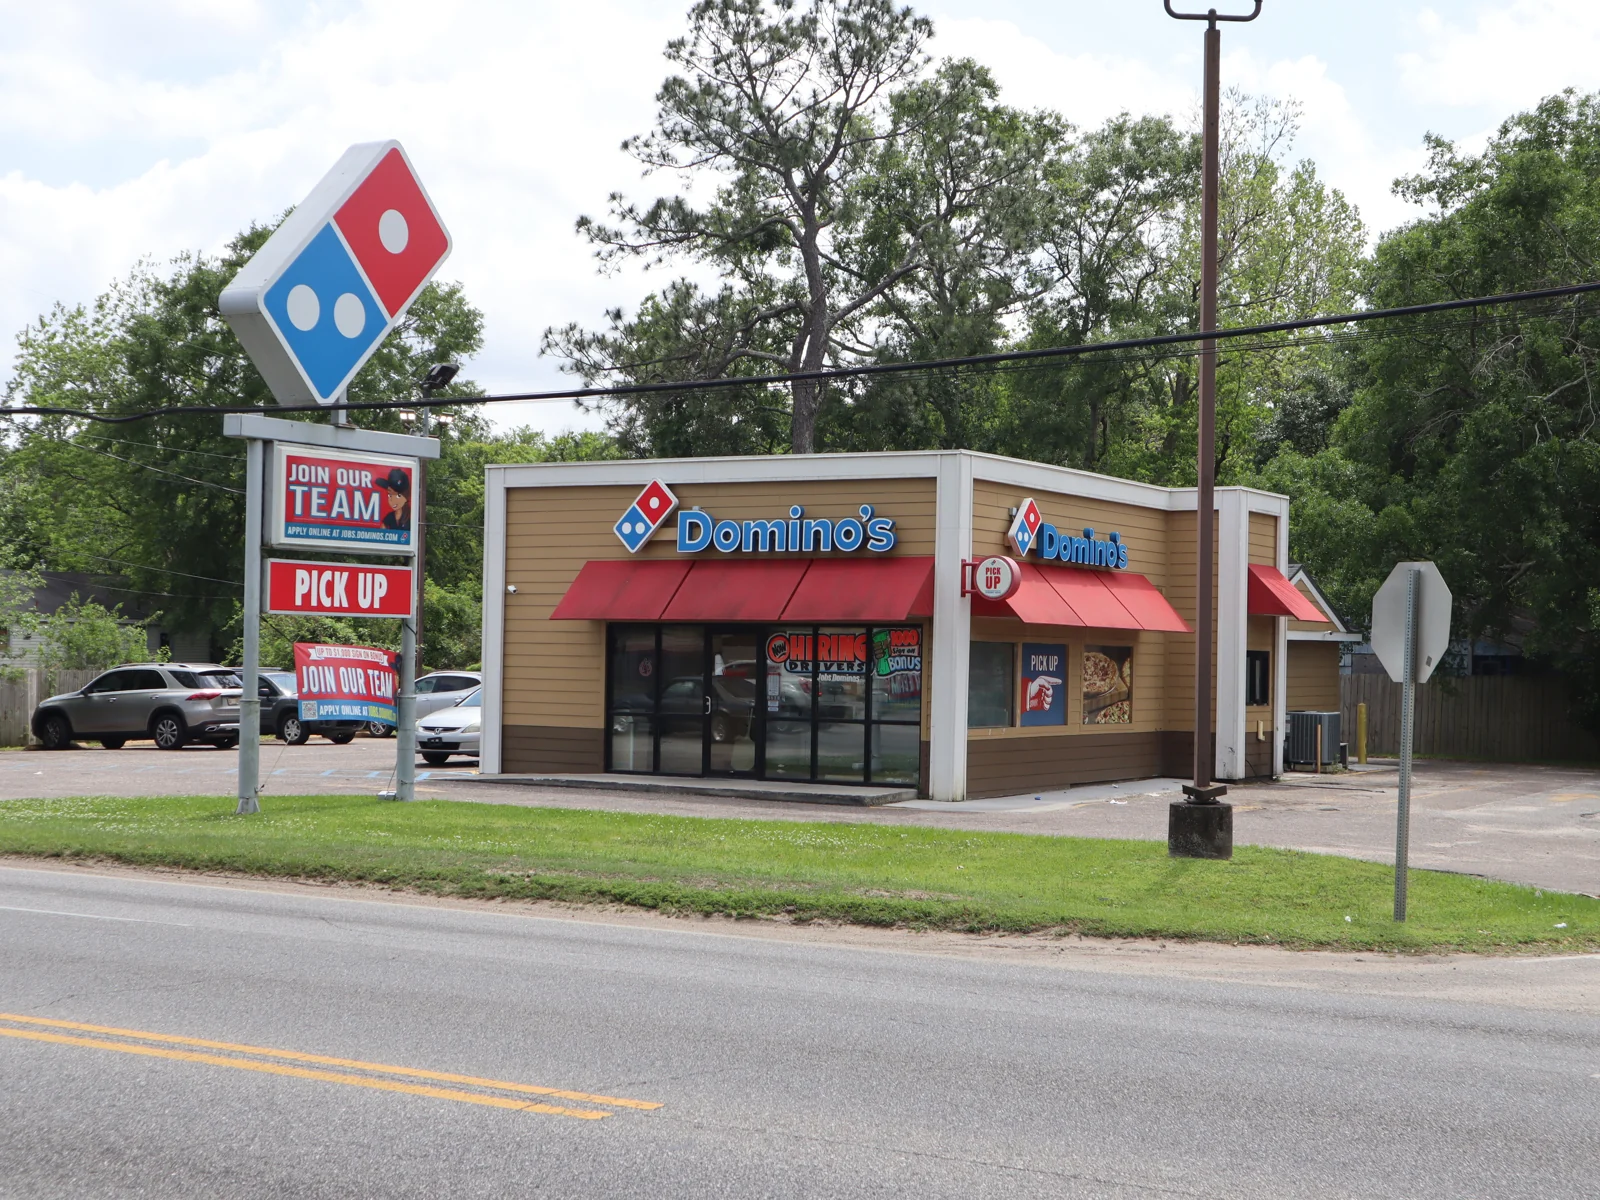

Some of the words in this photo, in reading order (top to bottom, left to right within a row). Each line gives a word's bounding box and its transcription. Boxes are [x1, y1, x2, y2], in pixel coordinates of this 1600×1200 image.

[289, 463, 330, 484] JOIN
[336, 468, 373, 488] OUR
[289, 485, 381, 521] TEAM
[287, 526, 307, 536] APPLY
[309, 527, 331, 538] ONLINE
[332, 529, 340, 538] AT
[340, 530, 398, 541] JOBS.DOMINOS.COM
[677, 504, 897, 553] Domino's
[1038, 523, 1128, 569] Domino's
[985, 567, 1001, 575] PICK
[295, 569, 349, 607] PICK
[357, 572, 388, 609] UP
[985, 575, 1001, 589] UP
[316, 647, 325, 656] UP
[325, 648, 332, 656] TO
[789, 634, 866, 661] HIRING
[788, 661, 865, 672] DRVERS
[1031, 655, 1048, 671] PICK
[1048, 655, 1059, 671] UP
[302, 665, 338, 694] JOIN
[339, 667, 368, 696] OUR
[367, 669, 393, 699] TEAM
[319, 704, 339, 716] APPLY
[341, 705, 362, 716] ONLINE
[362, 706, 368, 716] AT
